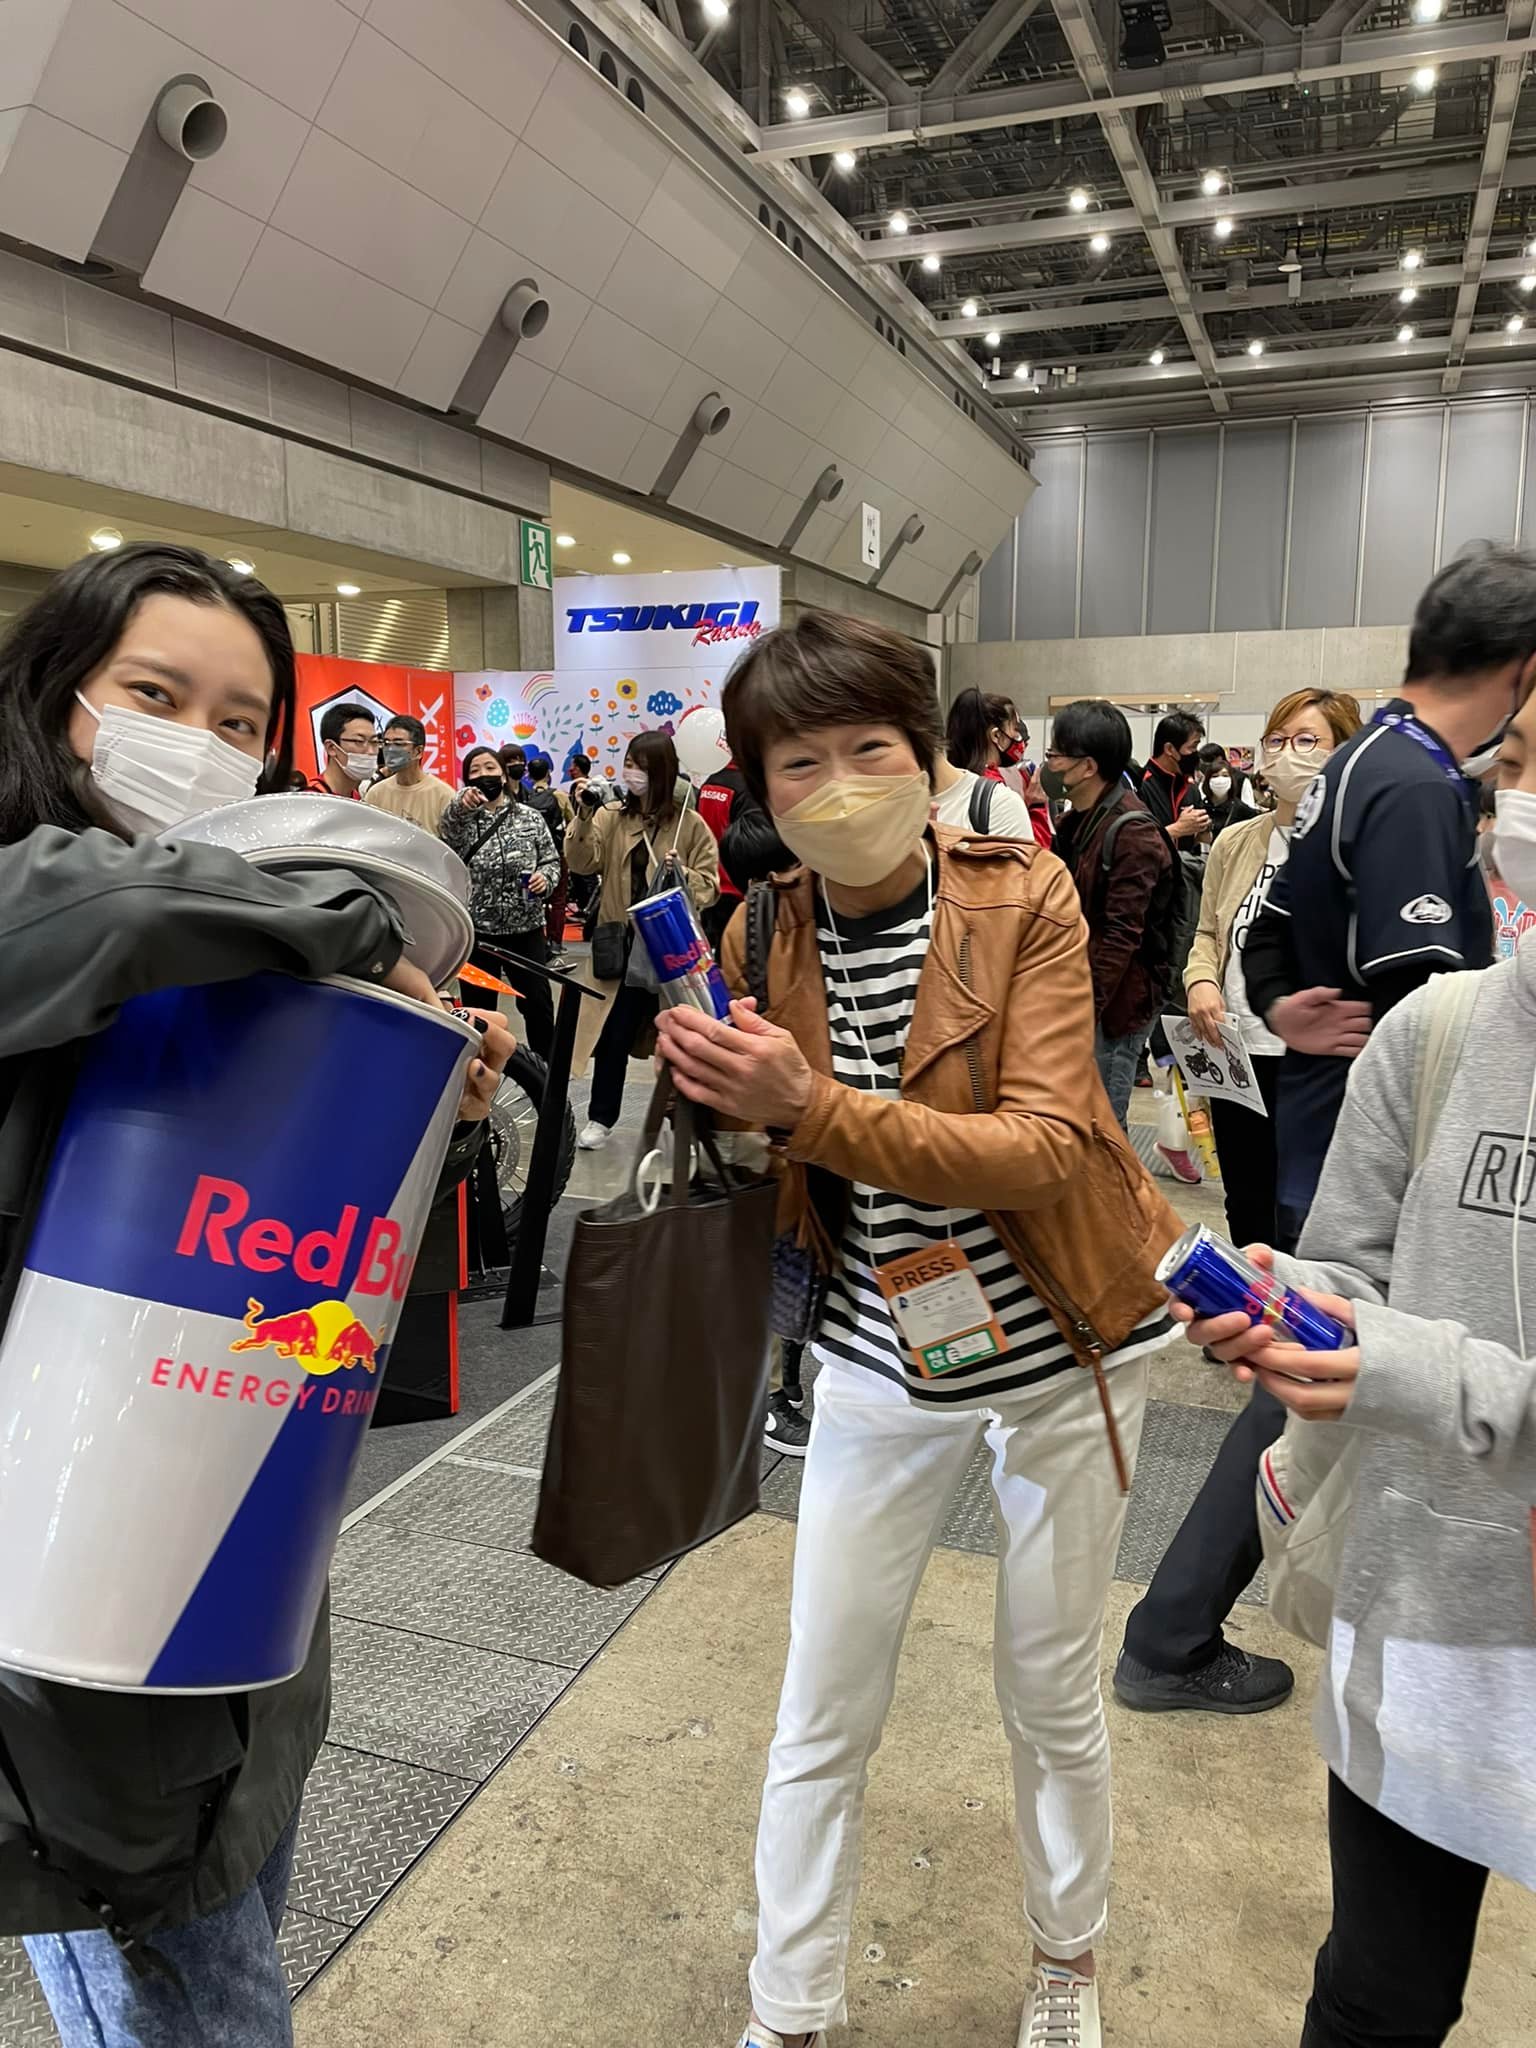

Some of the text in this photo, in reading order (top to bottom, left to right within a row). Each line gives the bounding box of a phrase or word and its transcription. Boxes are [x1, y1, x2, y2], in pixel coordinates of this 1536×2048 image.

[566, 601, 760, 633] TSUKIGI
[690, 617, 764, 647] Racing
[664, 942, 699, 970] Red
[175, 1174, 360, 1288] Red
[891, 1256, 956, 1292] PRESS
[150, 1357, 317, 1410] ENERGY
